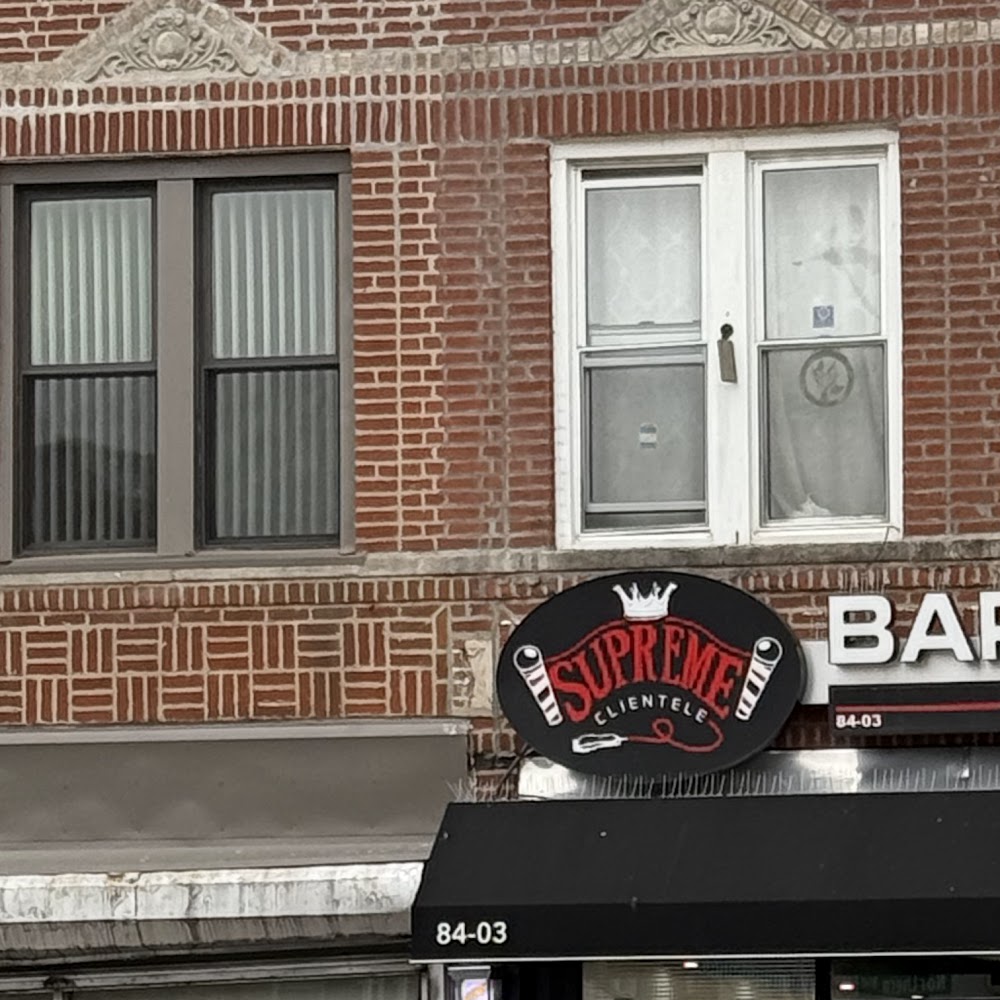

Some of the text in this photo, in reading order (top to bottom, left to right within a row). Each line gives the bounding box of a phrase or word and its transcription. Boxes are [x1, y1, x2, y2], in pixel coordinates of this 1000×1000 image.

[549, 624, 743, 723] SUPREME
[593, 694, 708, 725] CLIENTELE
[835, 714, 882, 728] 84-03
[436, 921, 508, 945] 84-03
